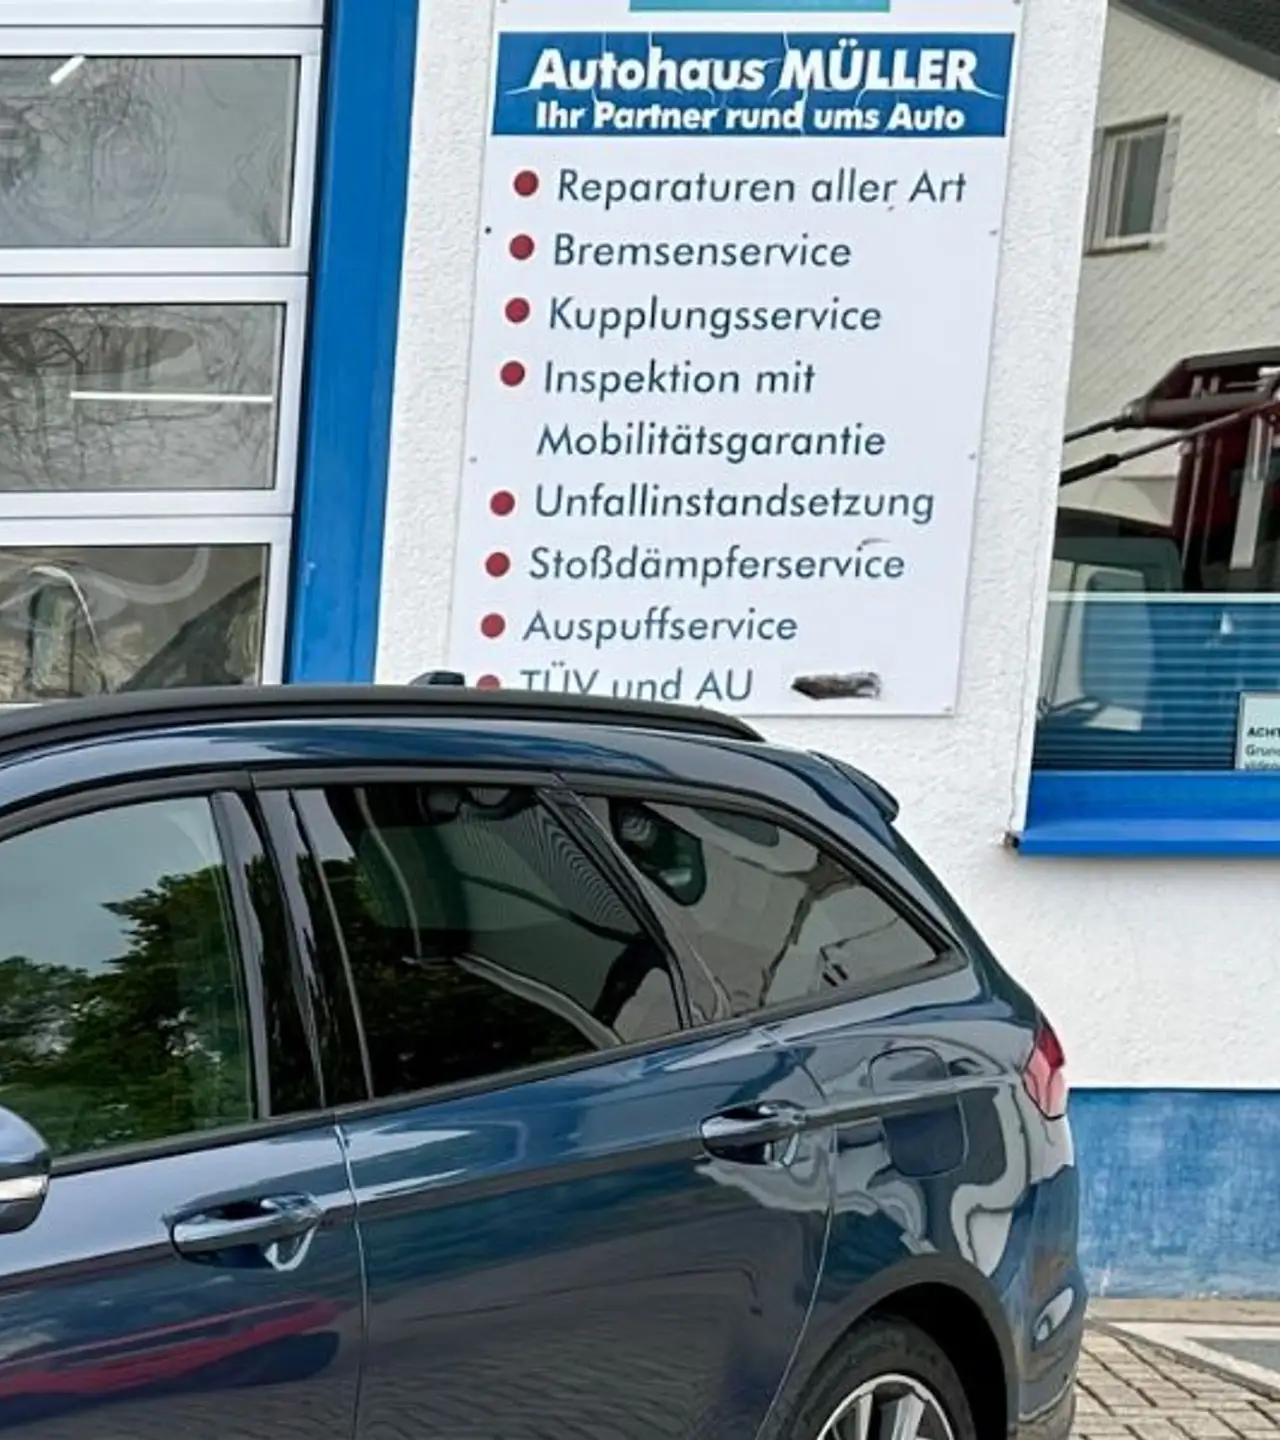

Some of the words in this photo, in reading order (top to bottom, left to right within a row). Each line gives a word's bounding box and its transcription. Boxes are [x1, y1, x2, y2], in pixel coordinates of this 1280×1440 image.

[529, 46, 765, 92] Autohaus
[779, 39, 979, 92] MÜLLER
[537, 101, 585, 129] Ihr
[594, 102, 717, 130] Partner
[726, 101, 804, 131] rund
[814, 107, 879, 131] ums
[887, 105, 966, 131] Auto
[558, 168, 796, 210] Reparaturen
[811, 168, 898, 203] aller
[910, 171, 966, 204] Art
[553, 233, 853, 267] Bremsenservice
[548, 294, 882, 339] Kupplungsservice
[544, 359, 740, 402] Inspektion
[755, 359, 815, 394] mit
[536, 421, 887, 465] Mobilitätsgarantie
[534, 483, 935, 525] Unfallinstandsetzung
[527, 544, 906, 588] Stoßdämpferservice
[521, 607, 798, 649] Auspuffservice
[520, 661, 601, 693] TÜV
[612, 668, 683, 701] und
[694, 670, 754, 701] AU
